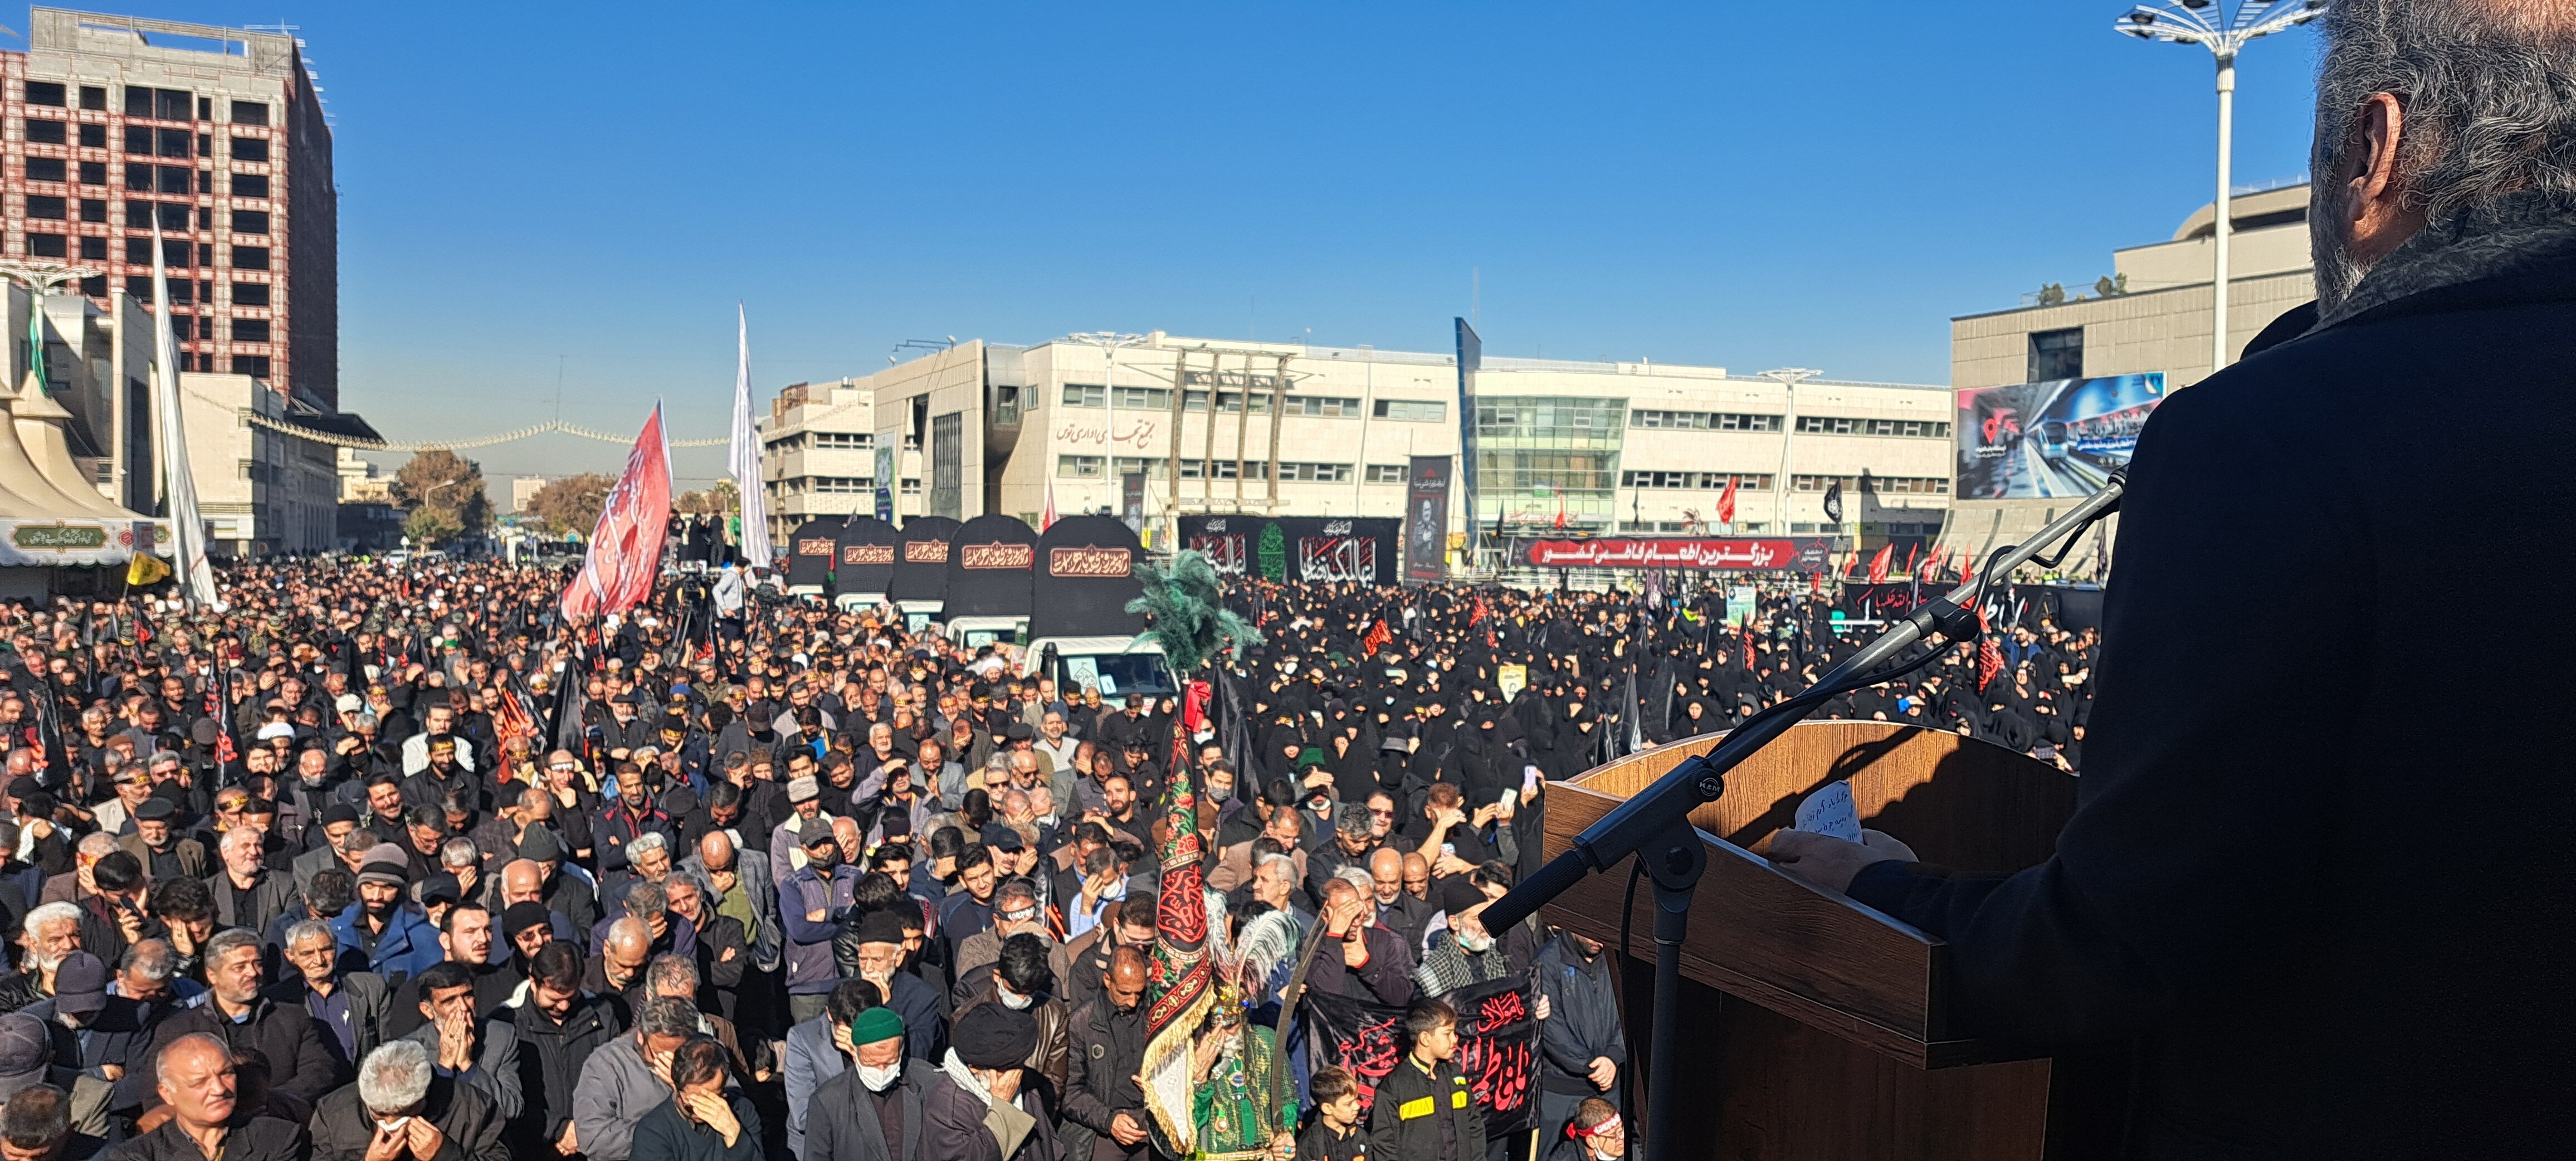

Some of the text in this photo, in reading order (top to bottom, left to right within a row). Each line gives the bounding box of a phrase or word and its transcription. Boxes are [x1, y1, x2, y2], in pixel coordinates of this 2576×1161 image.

[1070, 427, 1097, 443] اداری
[1096, 419, 1144, 445] تجای
[1137, 421, 1155, 449] مجتمع
[1541, 543, 1597, 563] کشور
[1594, 541, 1647, 565] فاطمی
[1698, 542, 1774, 567] بزرگترین
[1699, 782, 1721, 792] K&M
